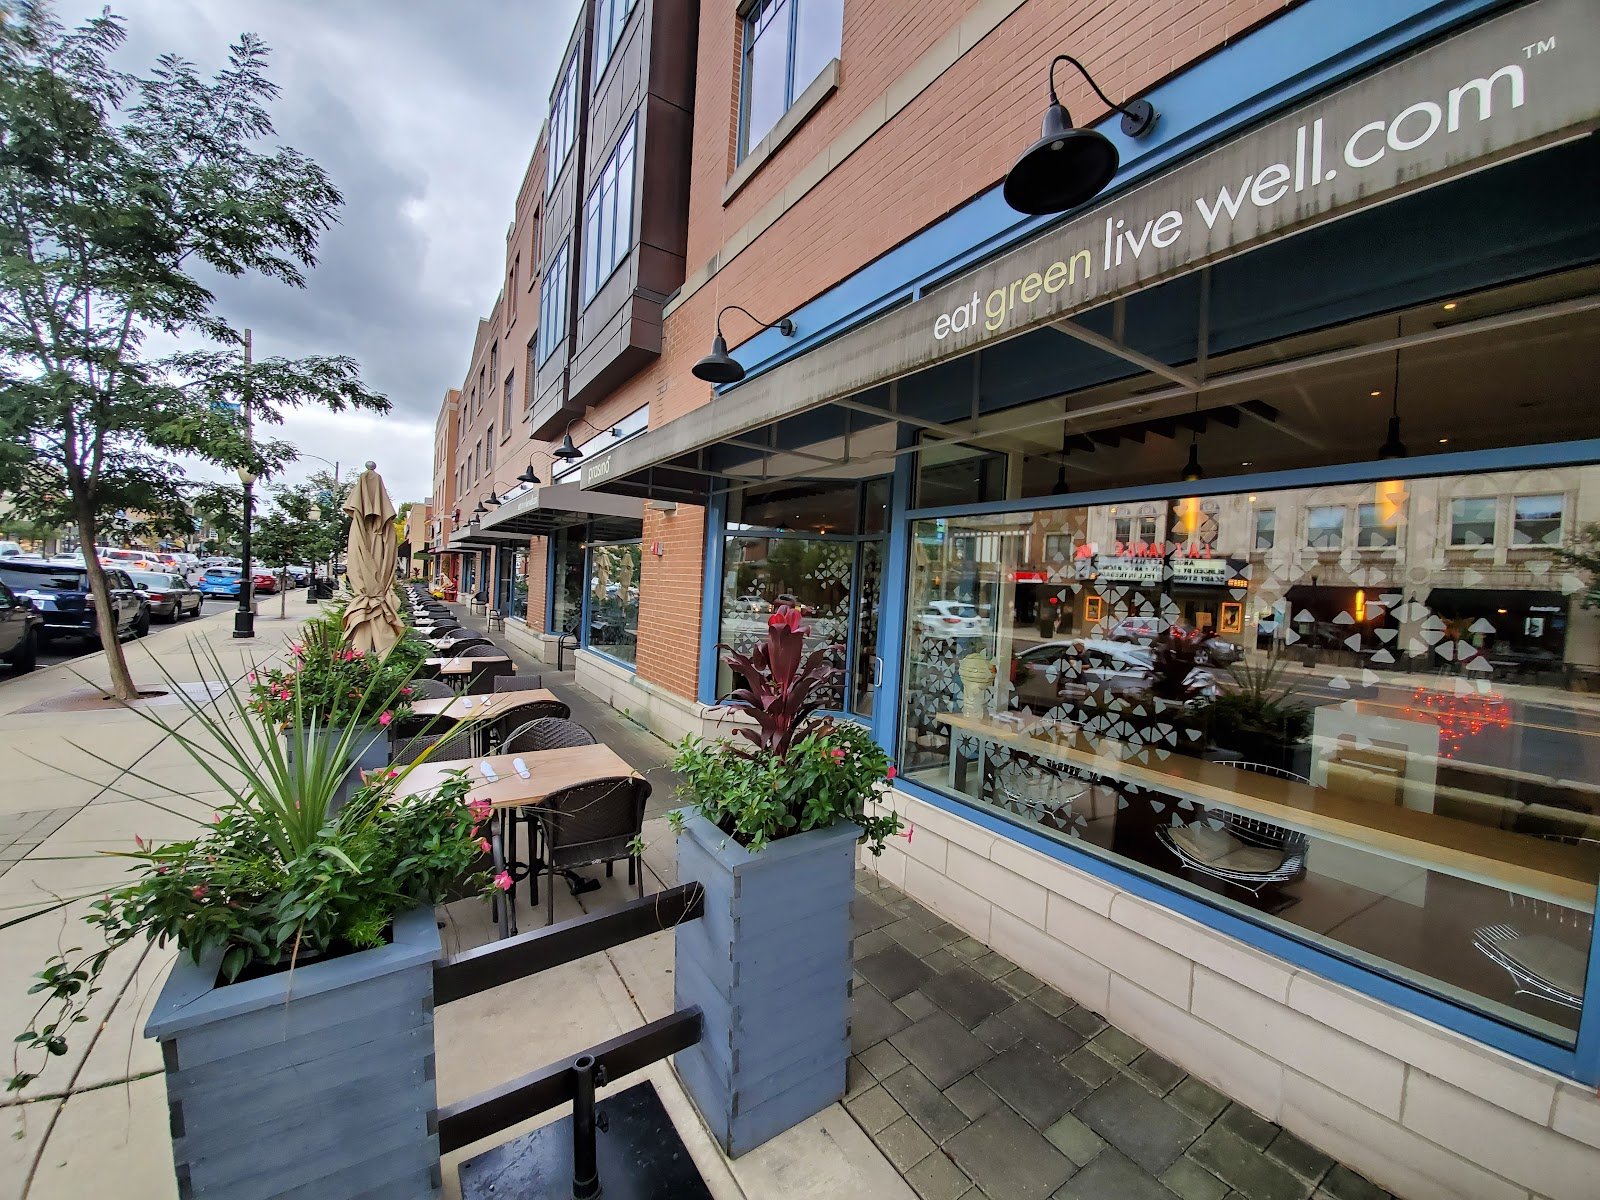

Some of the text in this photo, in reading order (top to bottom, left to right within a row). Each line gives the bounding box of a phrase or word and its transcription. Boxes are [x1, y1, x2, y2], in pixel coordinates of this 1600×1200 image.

[933, 290, 980, 340] eat
[984, 248, 1092, 331] green
[1103, 211, 1182, 271] live
[1195, 63, 1525, 230] well.com
